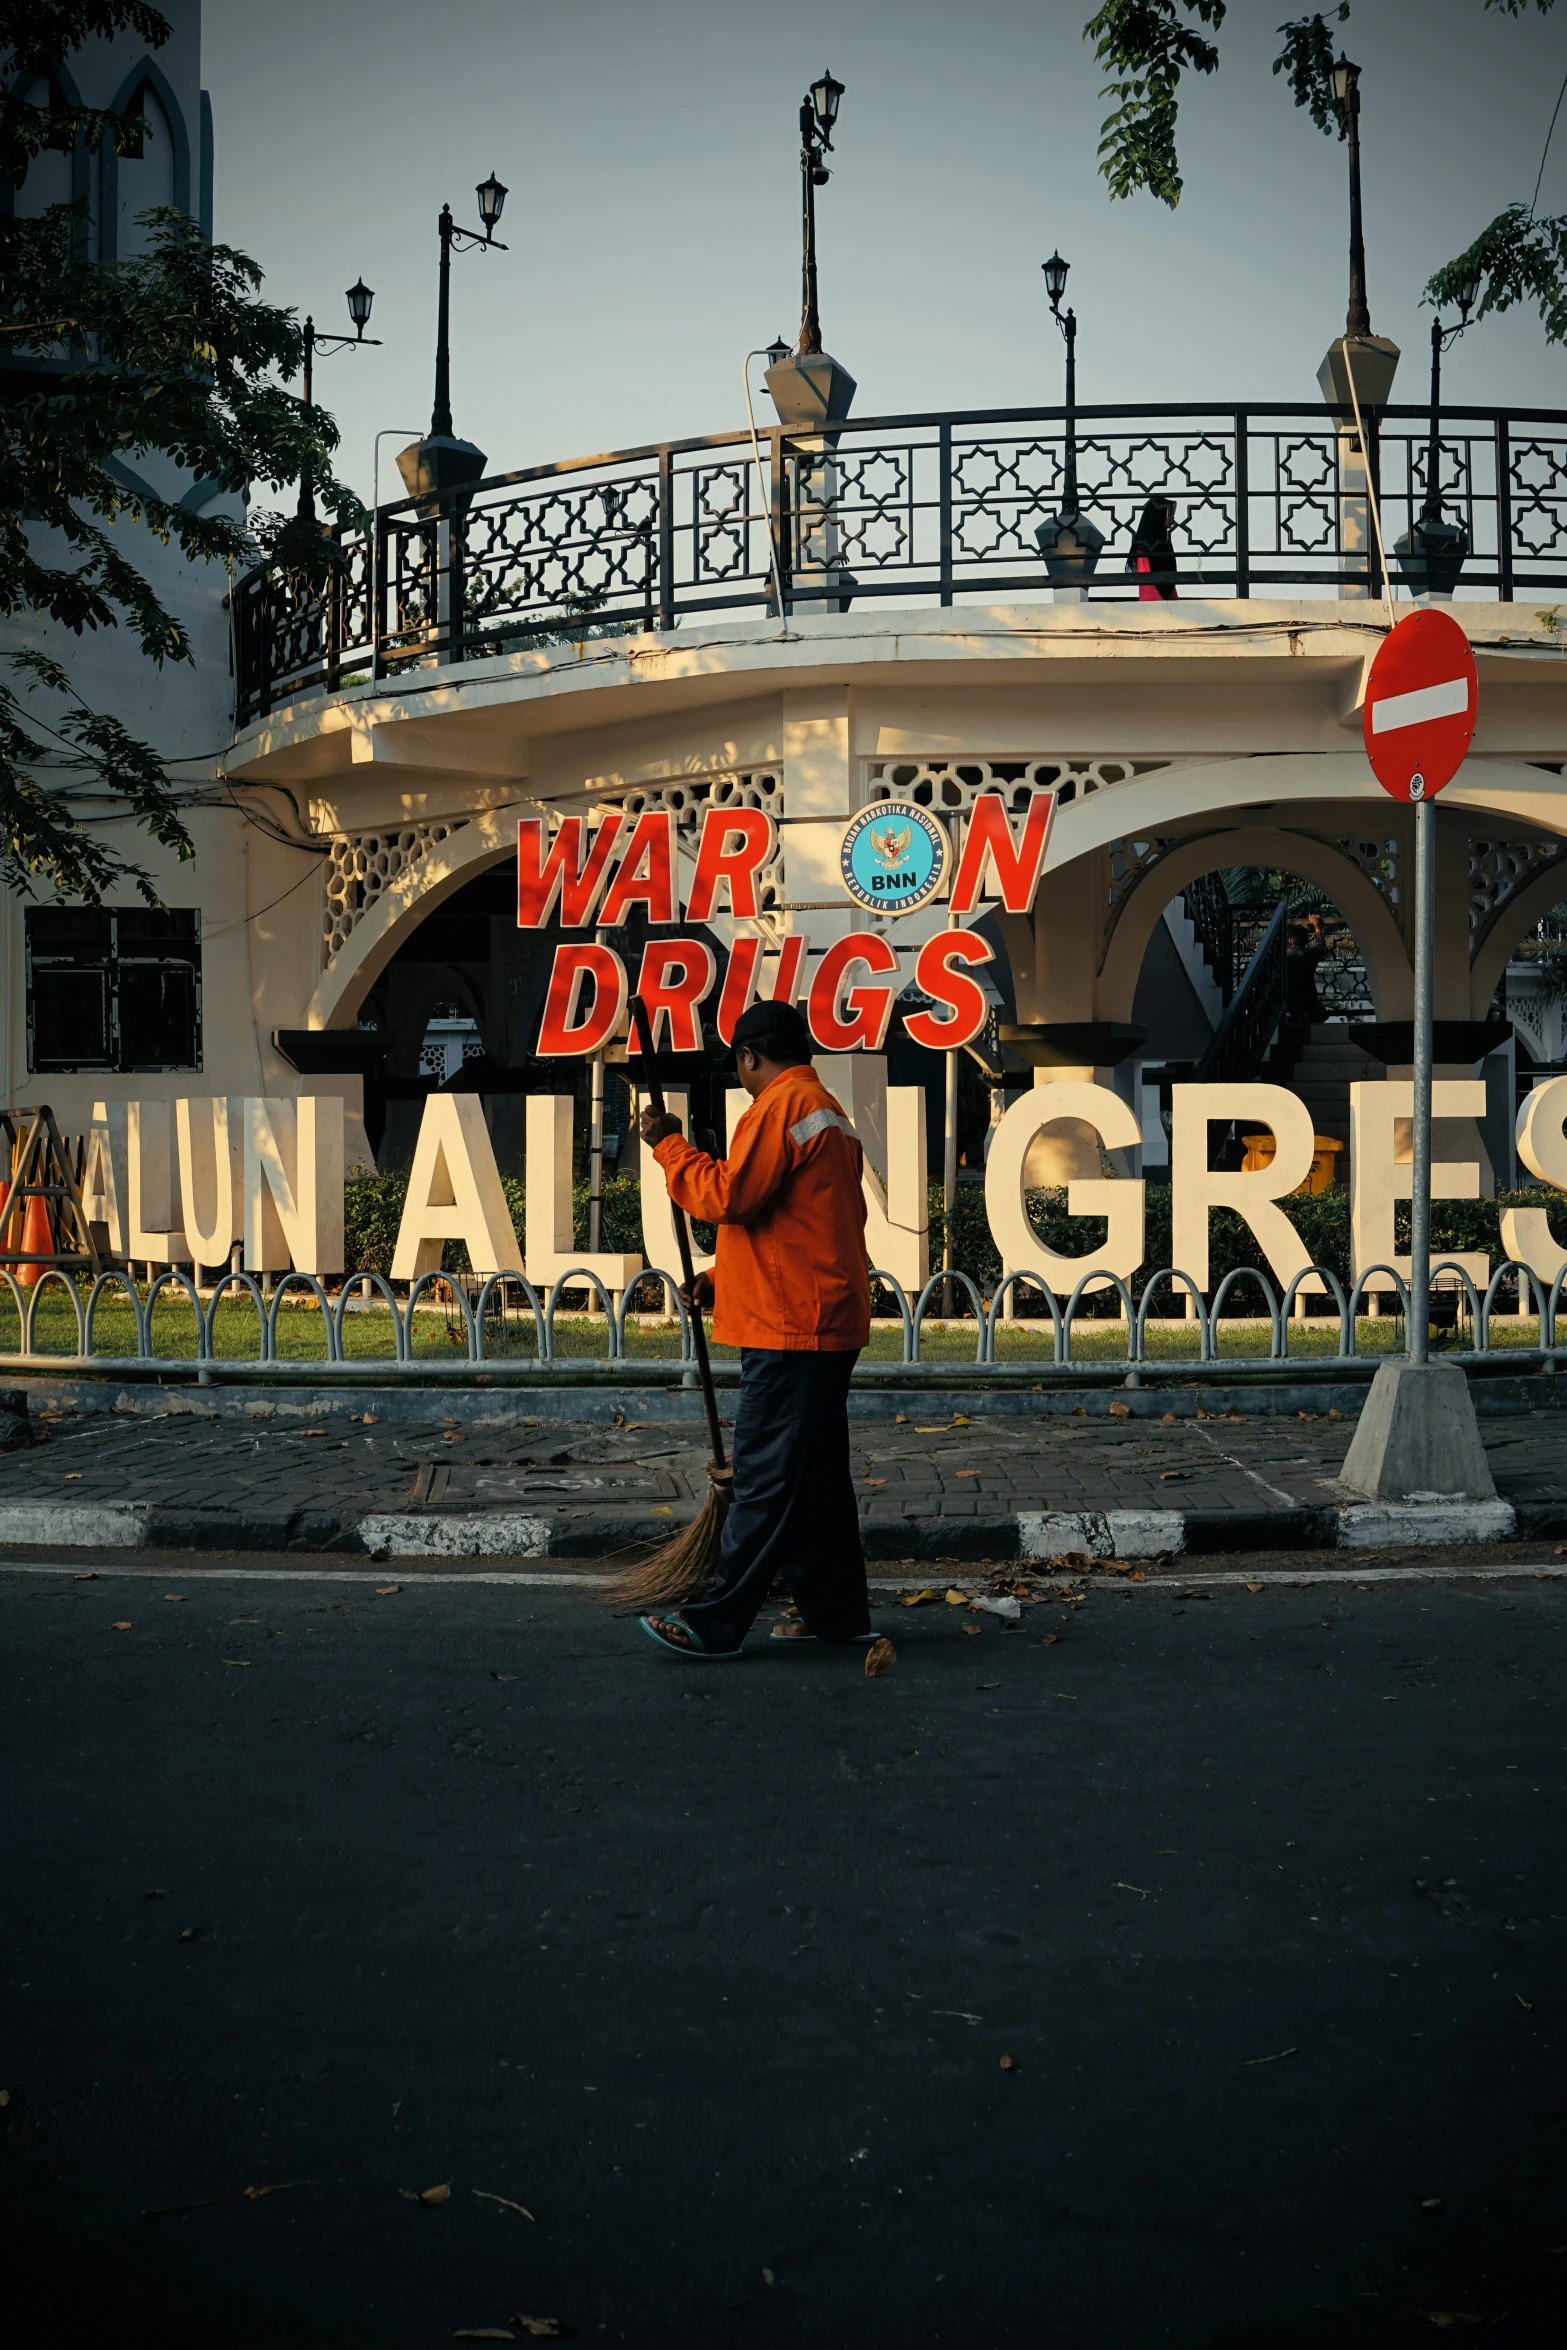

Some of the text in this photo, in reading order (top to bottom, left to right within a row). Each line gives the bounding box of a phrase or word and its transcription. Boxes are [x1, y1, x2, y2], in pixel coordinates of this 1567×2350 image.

[517, 807, 777, 929] WAR
[843, 805, 940, 853] BADAN NARKOTIKA NASIONAL
[845, 863, 942, 910] REPUBLIK INDONESIA
[872, 872, 917, 891] BNN
[535, 928, 995, 1056] DRUGS
[81, 1096, 344, 1275] ALUN
